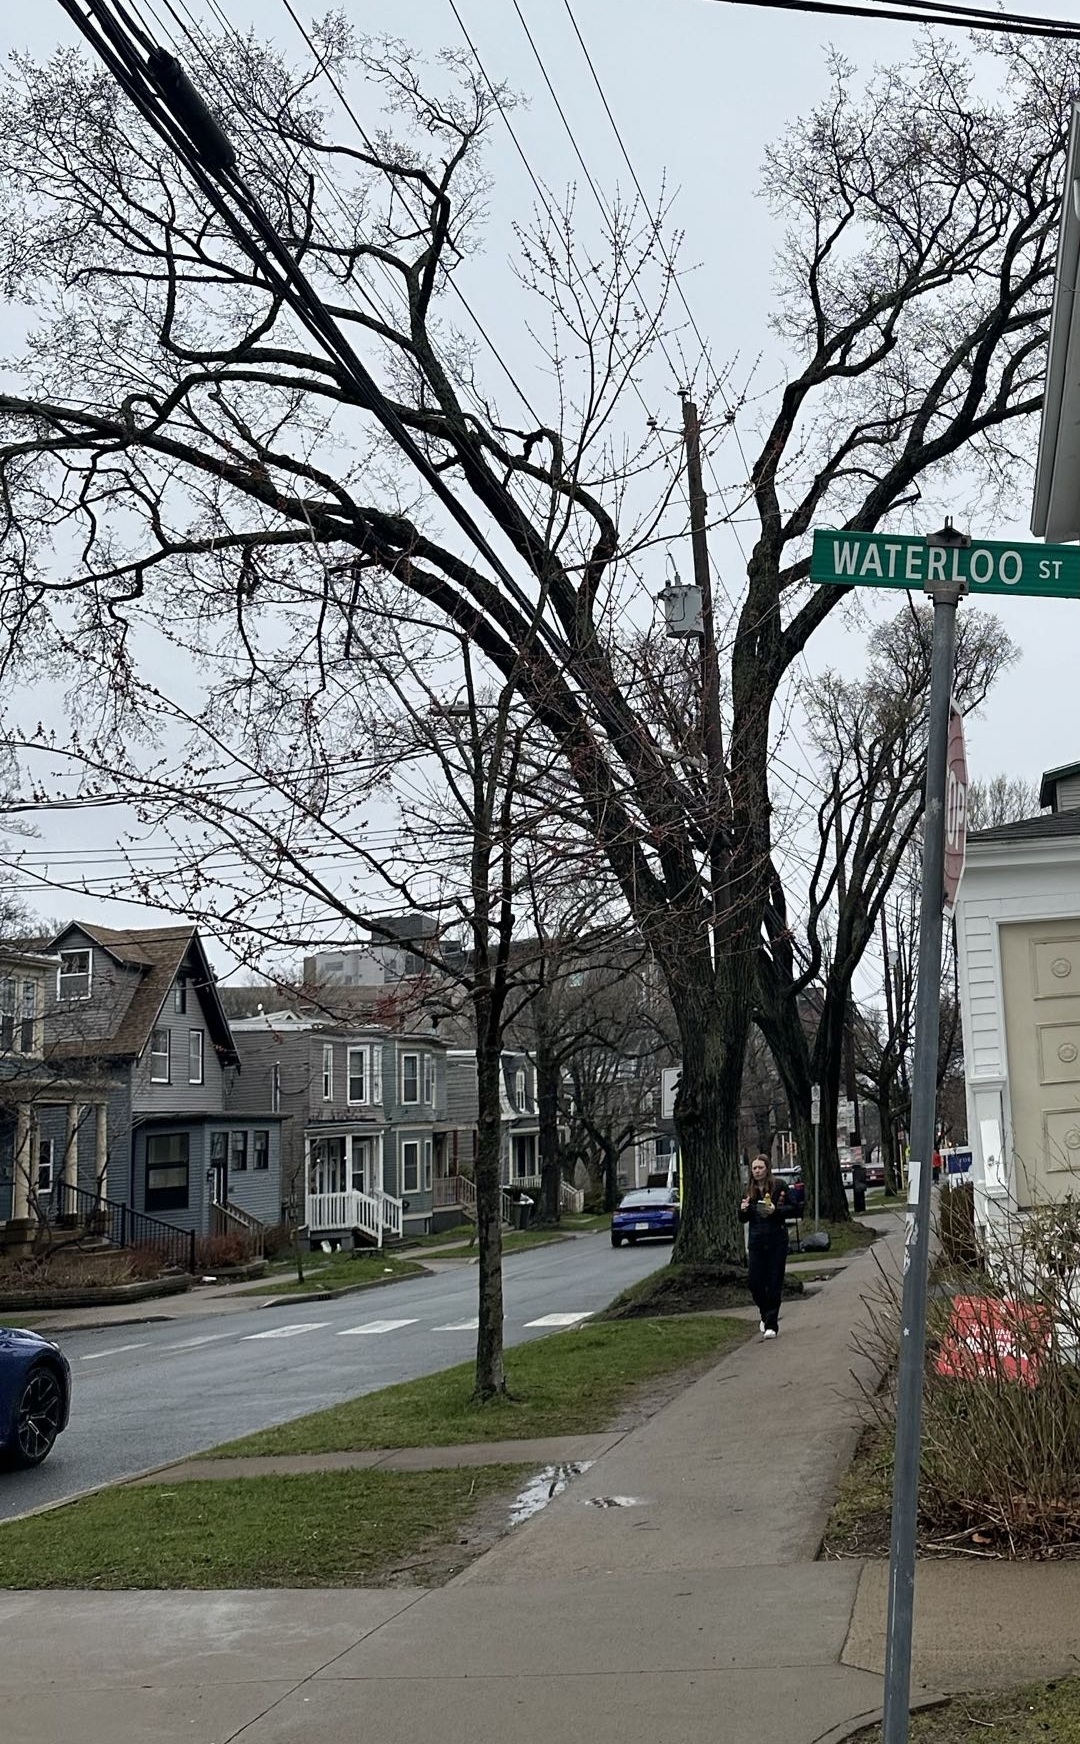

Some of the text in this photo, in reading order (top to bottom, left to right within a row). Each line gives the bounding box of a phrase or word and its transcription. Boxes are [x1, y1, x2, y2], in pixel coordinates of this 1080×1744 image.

[833, 540, 1063, 585] WATERLOO ST
[946, 764, 965, 851] OP
